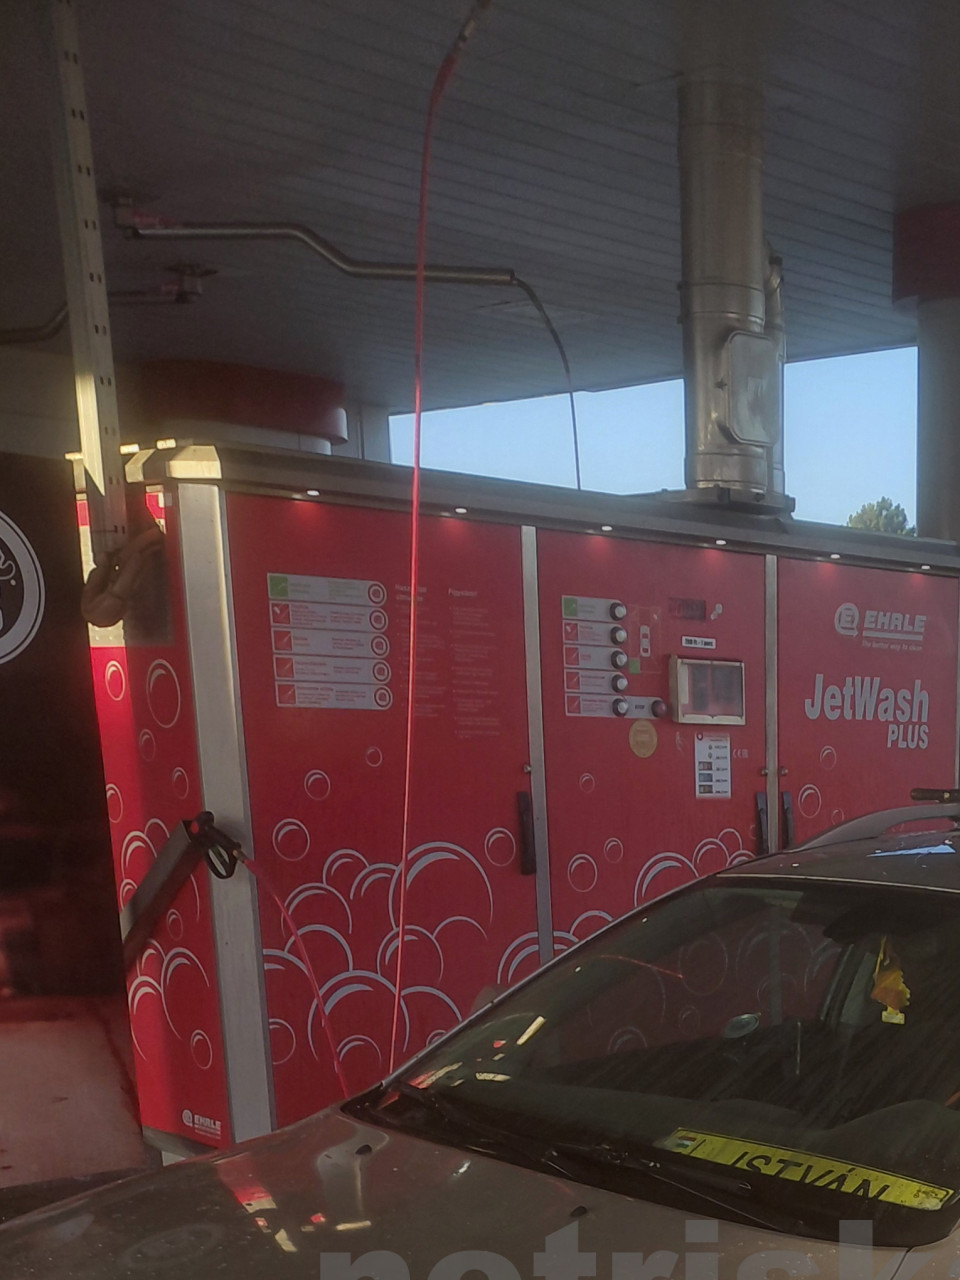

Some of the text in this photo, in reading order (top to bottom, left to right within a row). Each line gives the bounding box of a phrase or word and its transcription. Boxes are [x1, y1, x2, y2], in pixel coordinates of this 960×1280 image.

[864, 609, 927, 633] EHRLE
[804, 673, 929, 722] JetWash
[887, 723, 929, 749] PLUS
